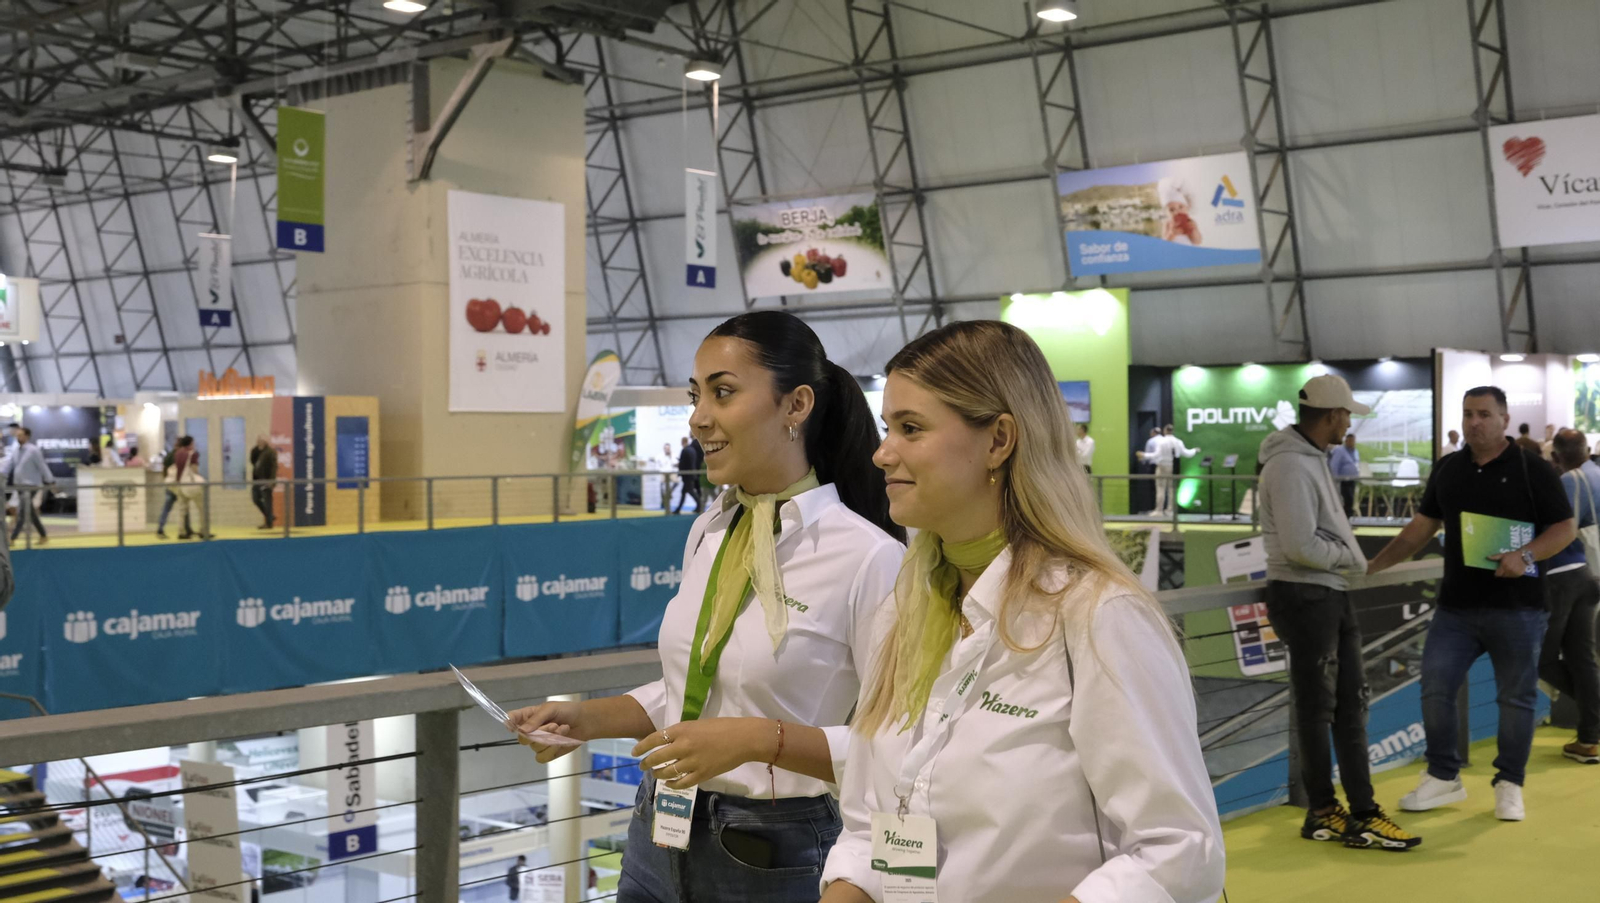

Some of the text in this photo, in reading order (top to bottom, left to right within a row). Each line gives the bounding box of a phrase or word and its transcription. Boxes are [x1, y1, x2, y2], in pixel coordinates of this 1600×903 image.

[1538, 172, 1600, 196] Víca
[781, 208, 828, 226] BERJA
[1214, 209, 1244, 222] adra
[294, 228, 307, 246] B
[458, 245, 545, 267] EXCELENCIA
[1080, 241, 1129, 255] Sabor de
[1082, 253, 1130, 265] confianza
[459, 263, 529, 284] AGRÍCOLA
[695, 269, 706, 284] A
[210, 313, 220, 325] A
[36, 438, 89, 449] FERVALLE
[304, 458, 314, 491] benos
[541, 574, 608, 599] cajamar
[654, 565, 682, 589] caja
[415, 585, 489, 611] cajamar
[270, 596, 355, 625] cajamar
[103, 609, 201, 640] cajamar
[345, 722, 361, 808] Sabadel
[667, 801, 687, 811] cajamar
[346, 834, 361, 853] B
[884, 829, 923, 849] Hazera
